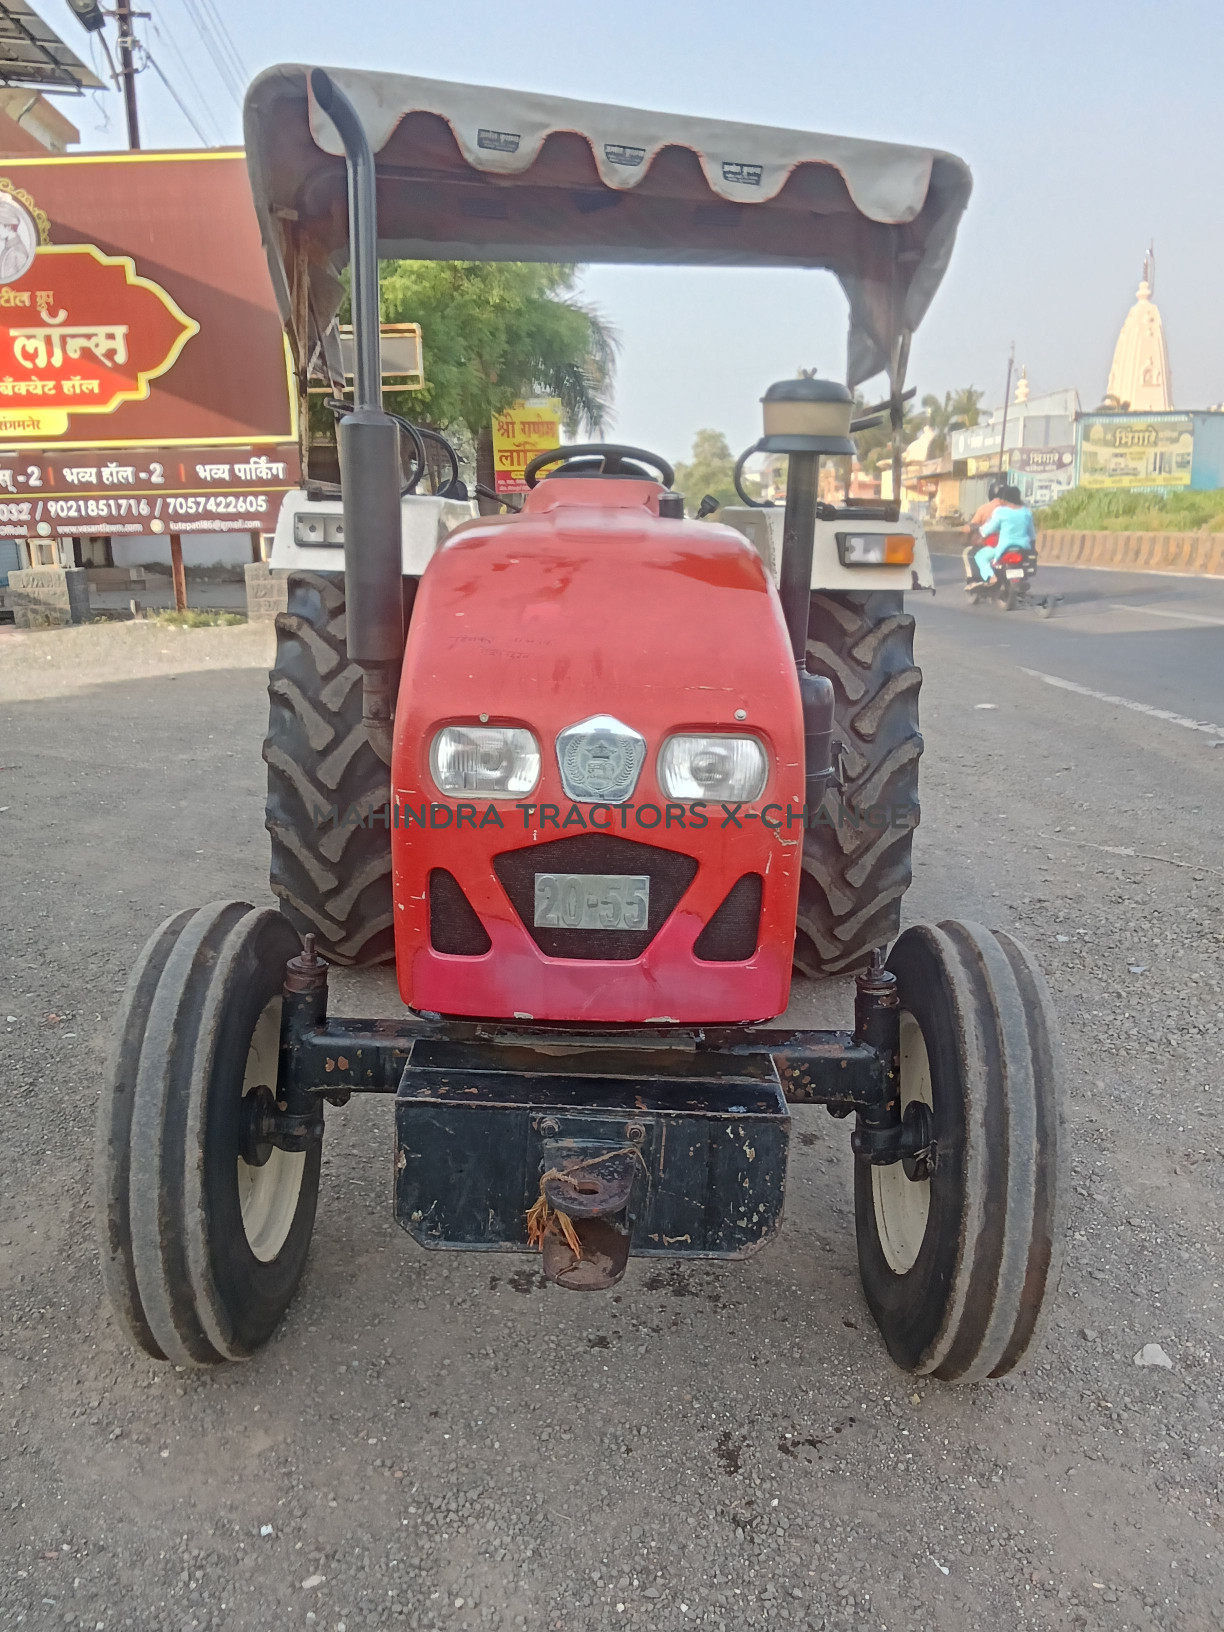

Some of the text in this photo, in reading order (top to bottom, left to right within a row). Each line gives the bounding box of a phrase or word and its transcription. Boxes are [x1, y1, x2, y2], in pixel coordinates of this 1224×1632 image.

[61, 376, 100, 395] हॉल
[498, 412, 555, 438] श्री गणेश
[63, 467, 99, 485] भव्य
[101, 462, 136, 485] हॉल
[195, 464, 230, 481] भव्य
[234, 456, 286, 480] पार्किंग
[47, 498, 151, 518] 9021851716
[166, 495, 268, 515] 7057422605
[536, 875, 647, 928] 20-55
